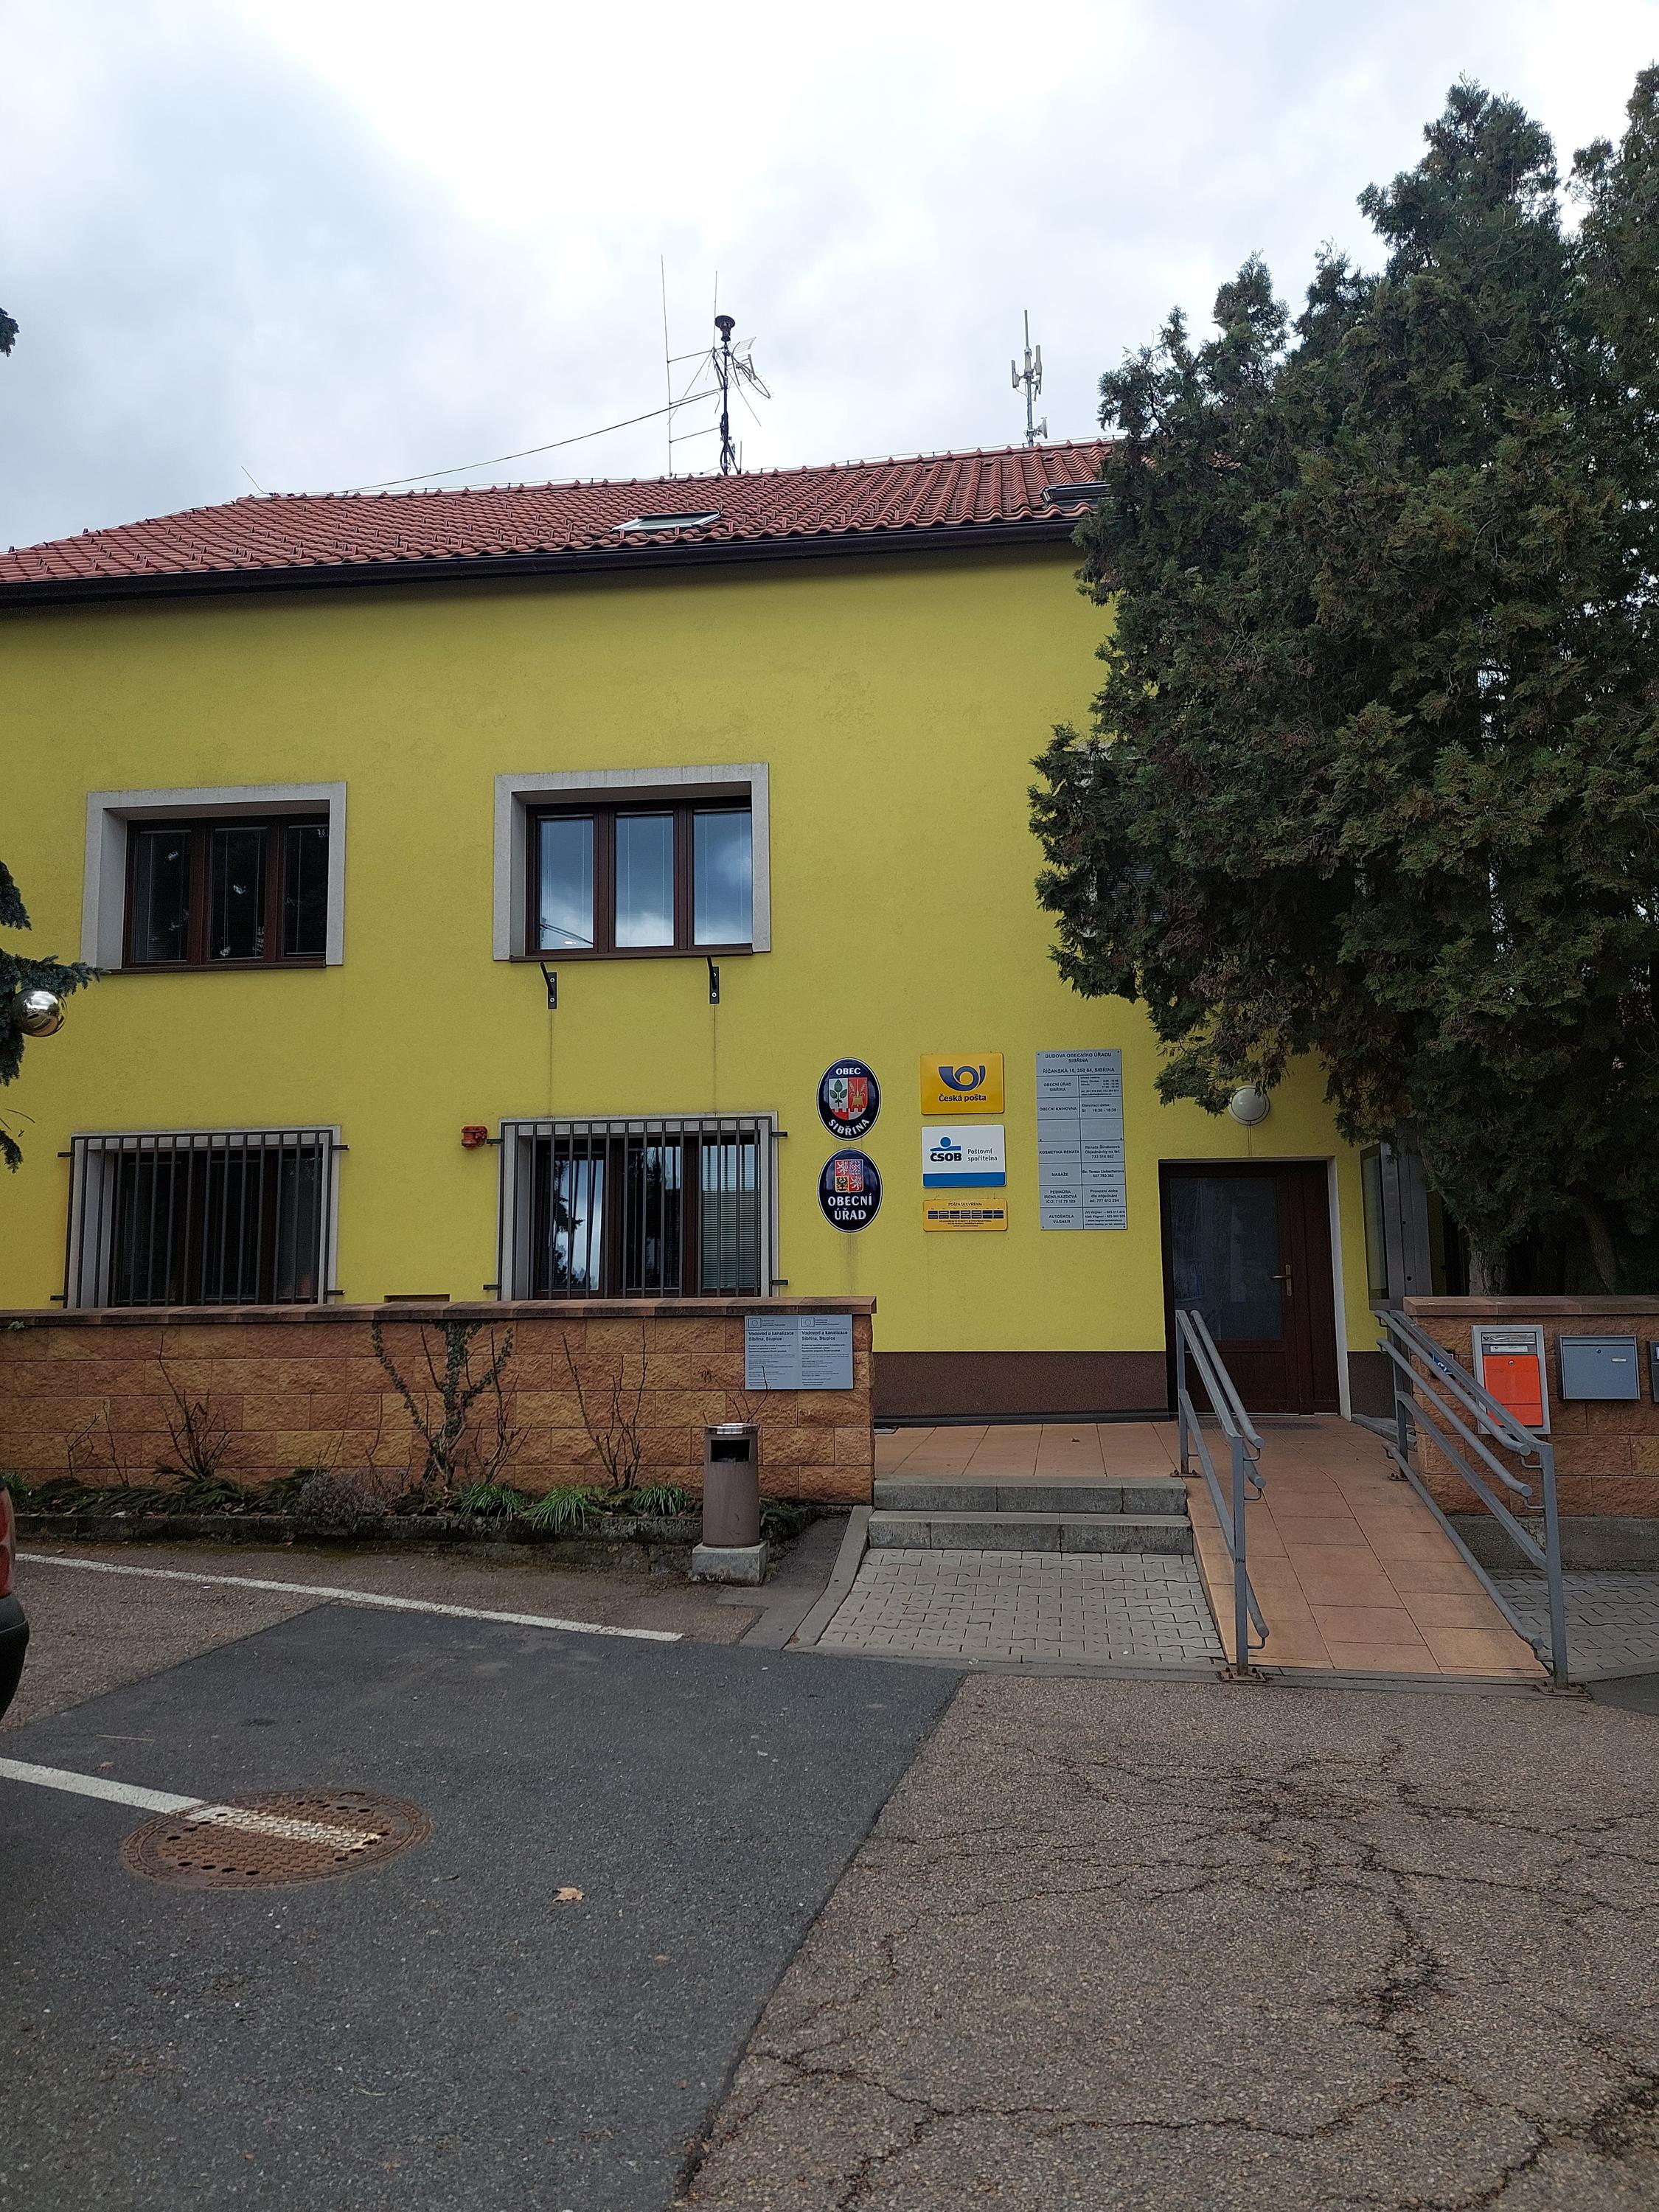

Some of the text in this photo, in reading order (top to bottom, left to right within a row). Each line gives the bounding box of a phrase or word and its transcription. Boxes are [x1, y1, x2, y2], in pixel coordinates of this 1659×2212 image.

[939, 1093, 987, 1102] Česká pošta
[829, 1119, 870, 1135] SIBŘINA
[931, 1152, 961, 1162] ČSOB
[827, 1193, 872, 1206] OBECNÍ
[835, 1208, 866, 1220] ÚŘAD
